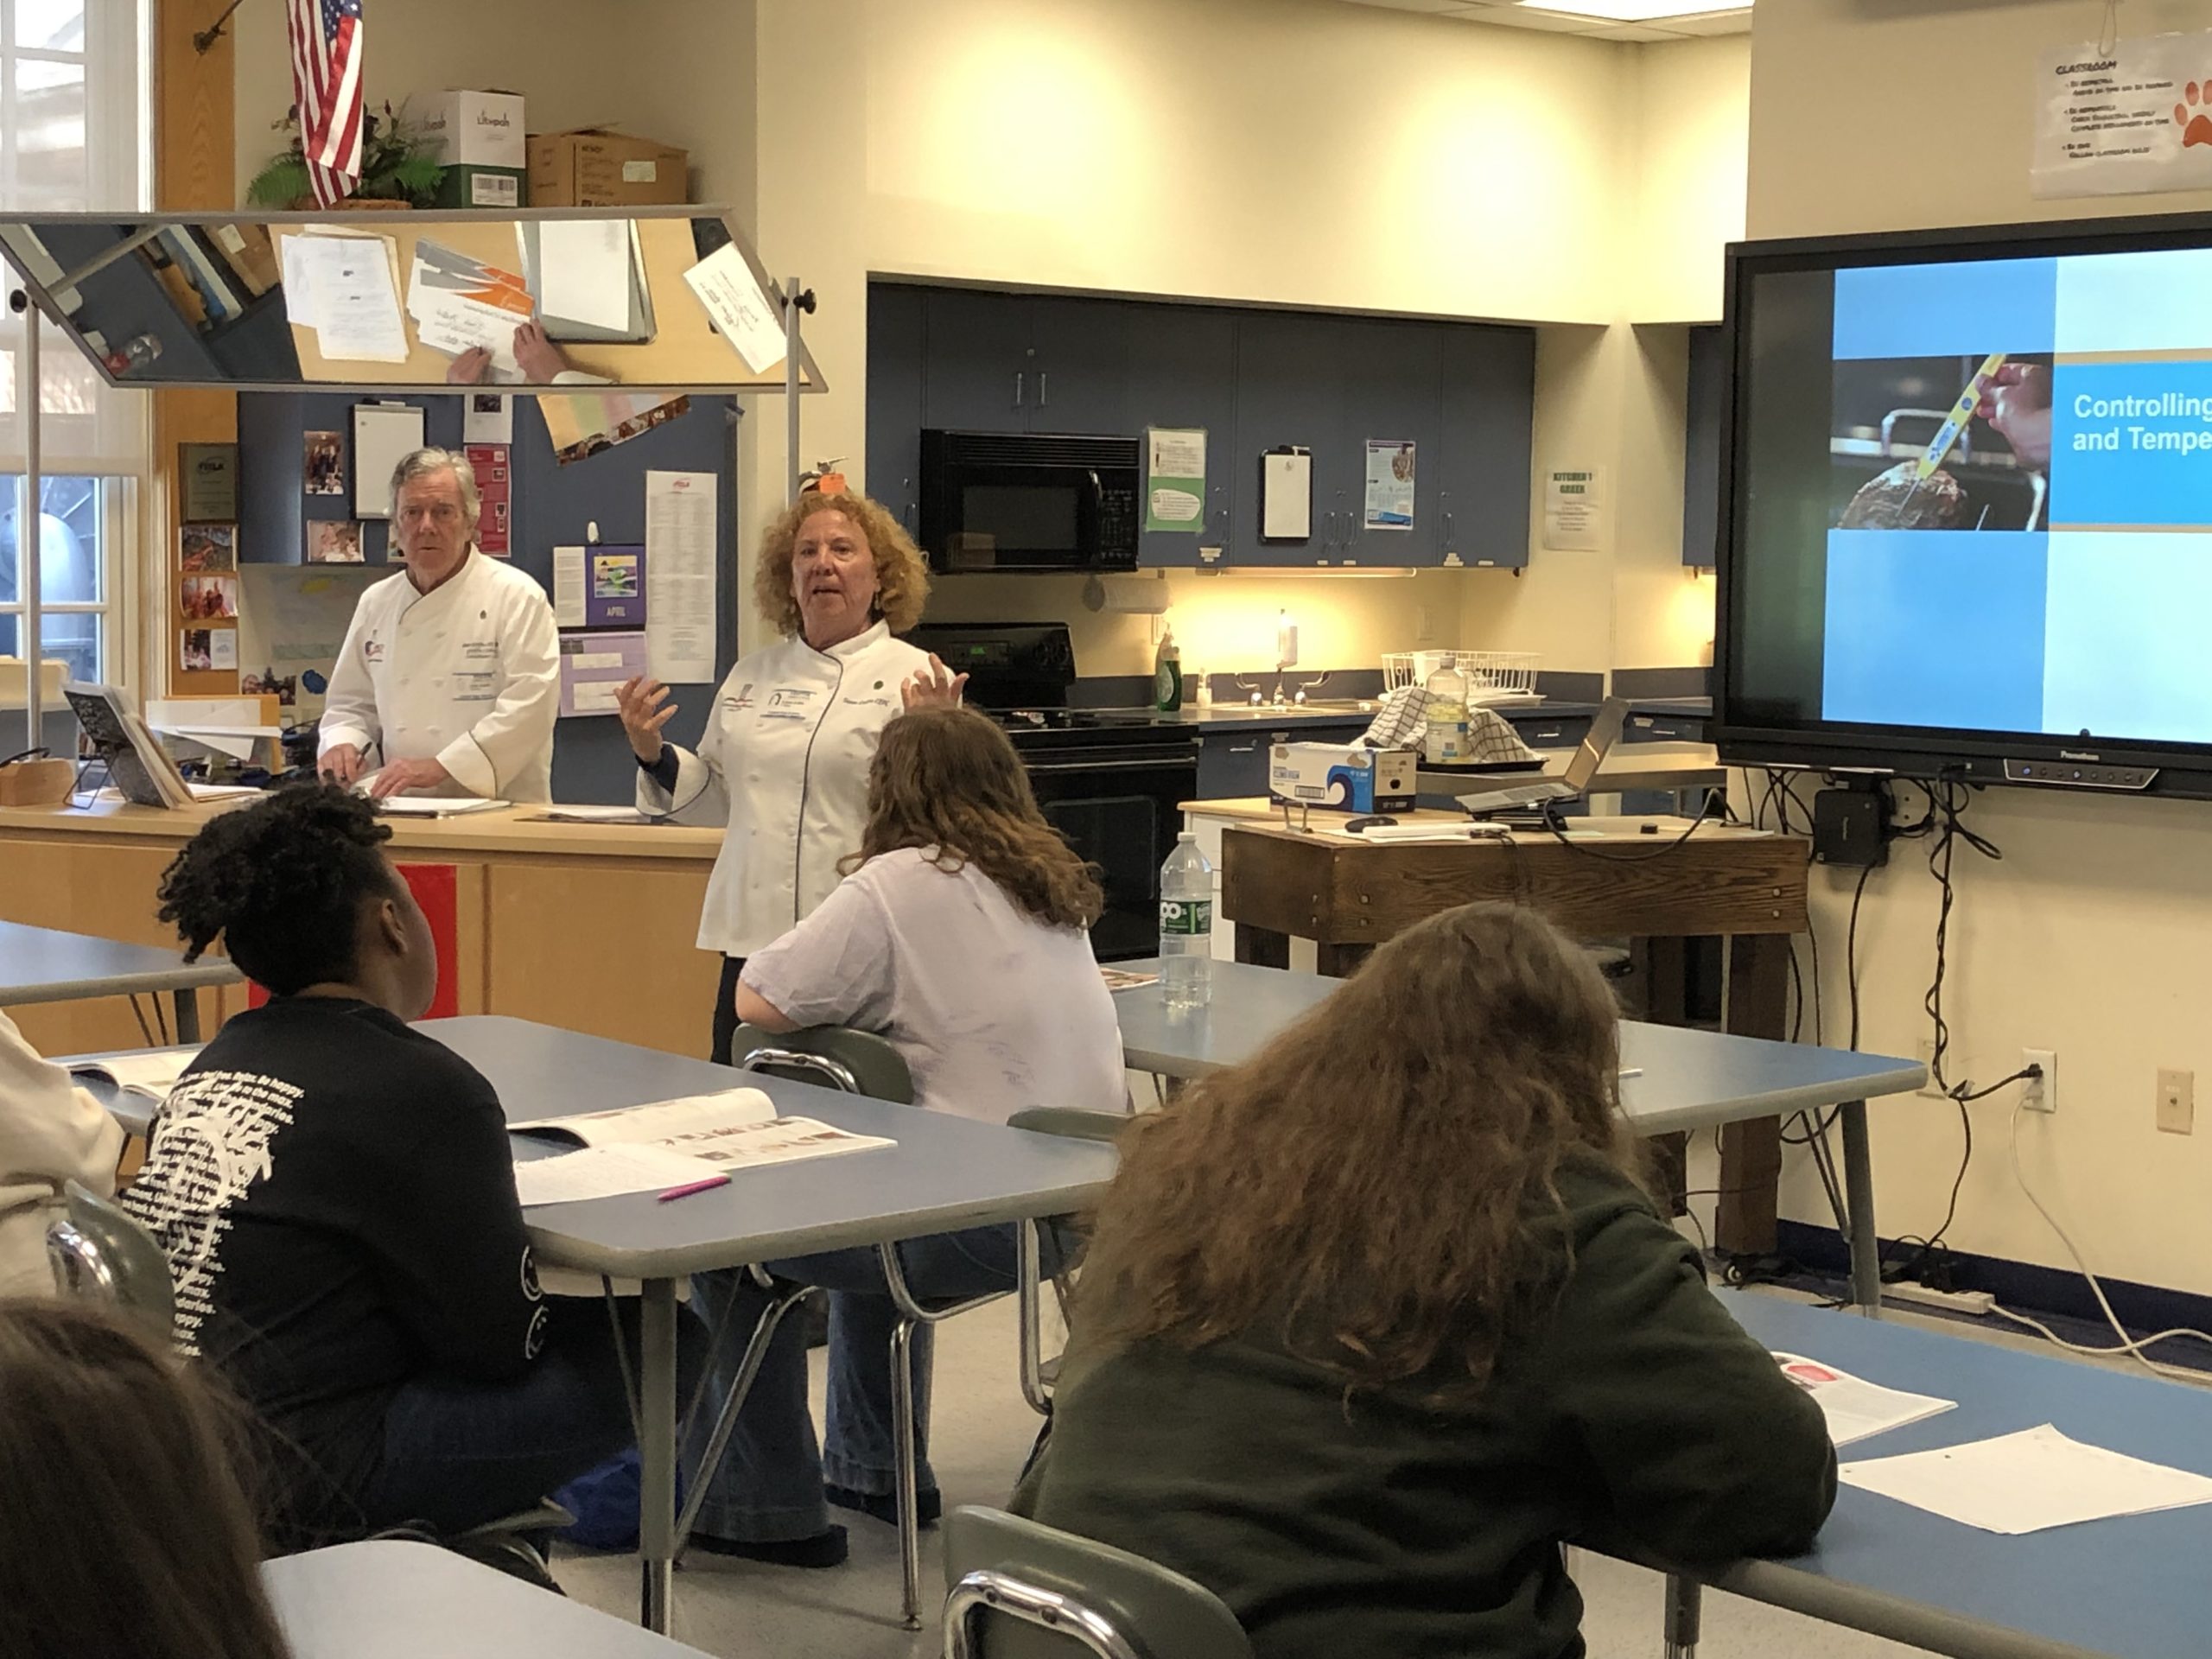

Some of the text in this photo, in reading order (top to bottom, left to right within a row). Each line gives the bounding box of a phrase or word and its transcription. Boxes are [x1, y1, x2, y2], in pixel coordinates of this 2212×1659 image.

[2056, 61, 2117, 74] CLASSROOM
[2074, 392, 2212, 423] Controlling
[2072, 426, 2212, 456] and Tempe
[269, 1077, 305, 1099] happy.
[267, 1091, 294, 1109] max.
